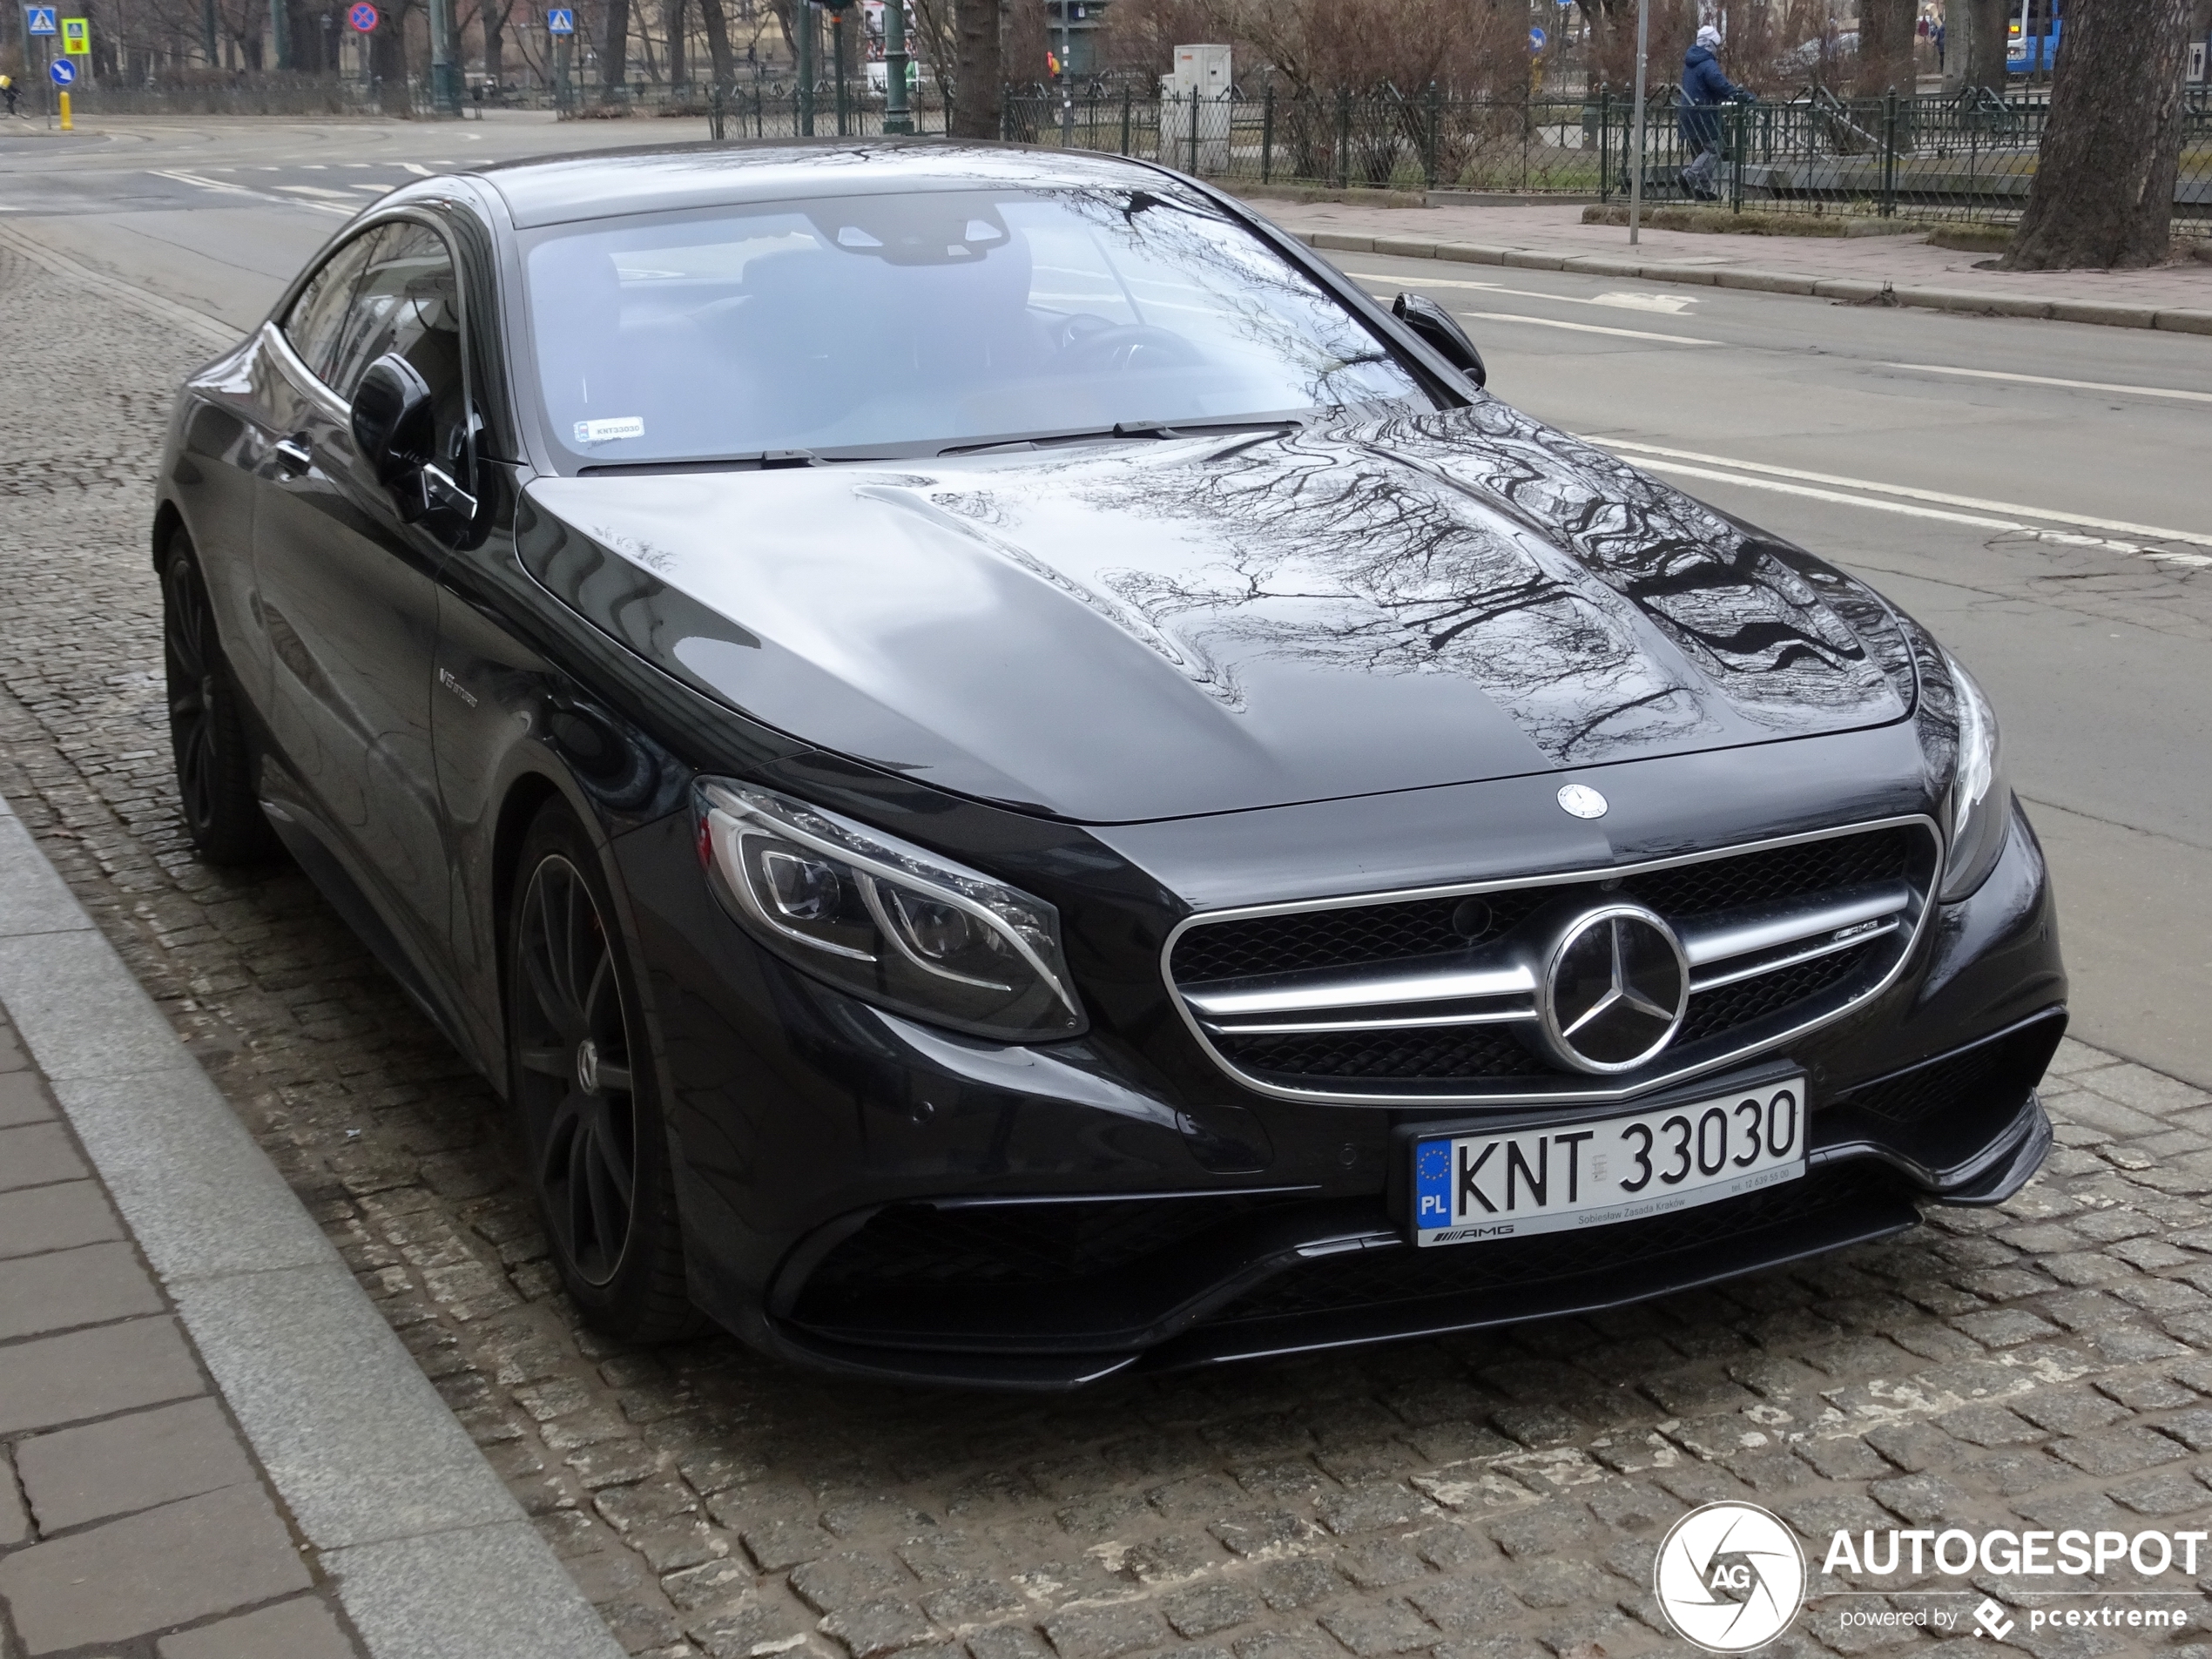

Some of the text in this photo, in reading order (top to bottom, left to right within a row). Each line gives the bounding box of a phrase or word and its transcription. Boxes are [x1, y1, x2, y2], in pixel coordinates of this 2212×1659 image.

[597, 425, 639, 435] KNT33030
[1458, 1089, 1797, 1217] KNT 33030
[1731, 1169, 1790, 1193] tel. 12 639 55 00
[1421, 1195, 1447, 1216] PL
[1578, 1197, 1685, 1225] Sobiesław Zasada Kraków
[1461, 1224, 1514, 1238] AMG
